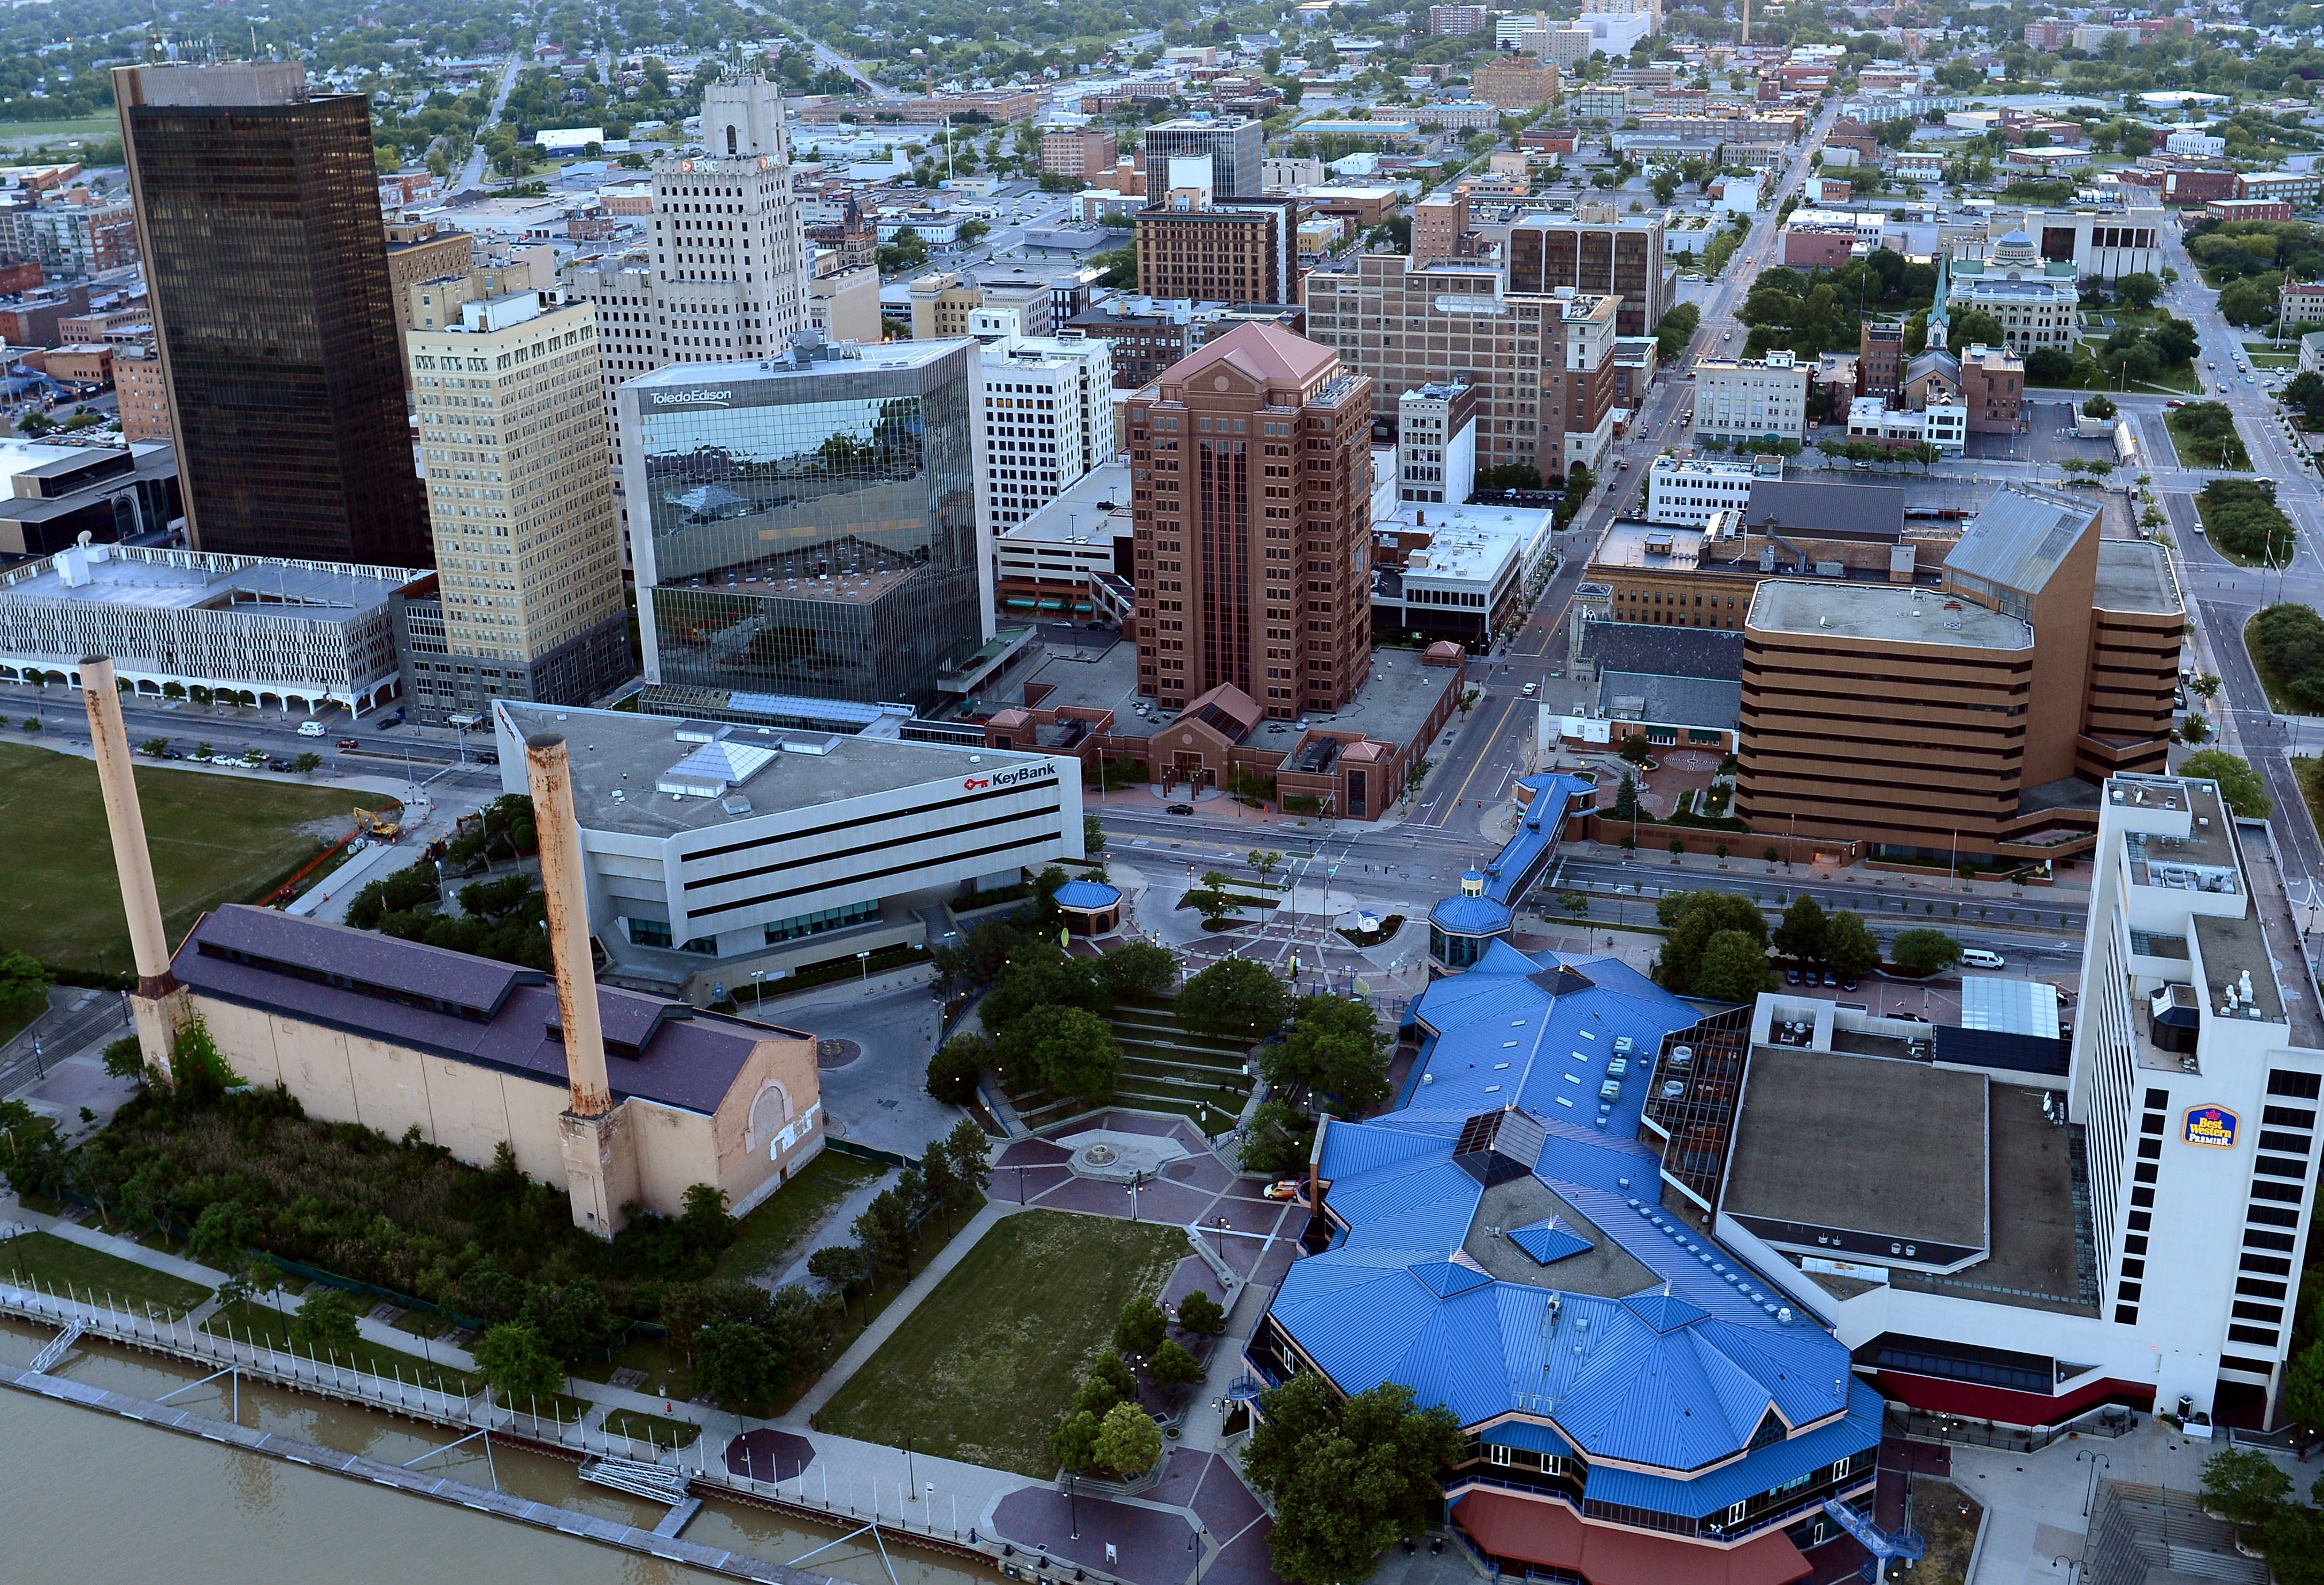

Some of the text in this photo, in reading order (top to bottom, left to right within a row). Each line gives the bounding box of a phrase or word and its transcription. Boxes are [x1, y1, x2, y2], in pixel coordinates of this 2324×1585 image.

[693, 160, 718, 172] PNC
[767, 154, 781, 167] PNC
[650, 389, 731, 404] ToledoEdison
[992, 763, 1056, 786] KeyBank
[2199, 1117, 2223, 1129] Best
[2189, 1124, 2231, 1138] Western
[2188, 1133, 2229, 1146] PREMIER
